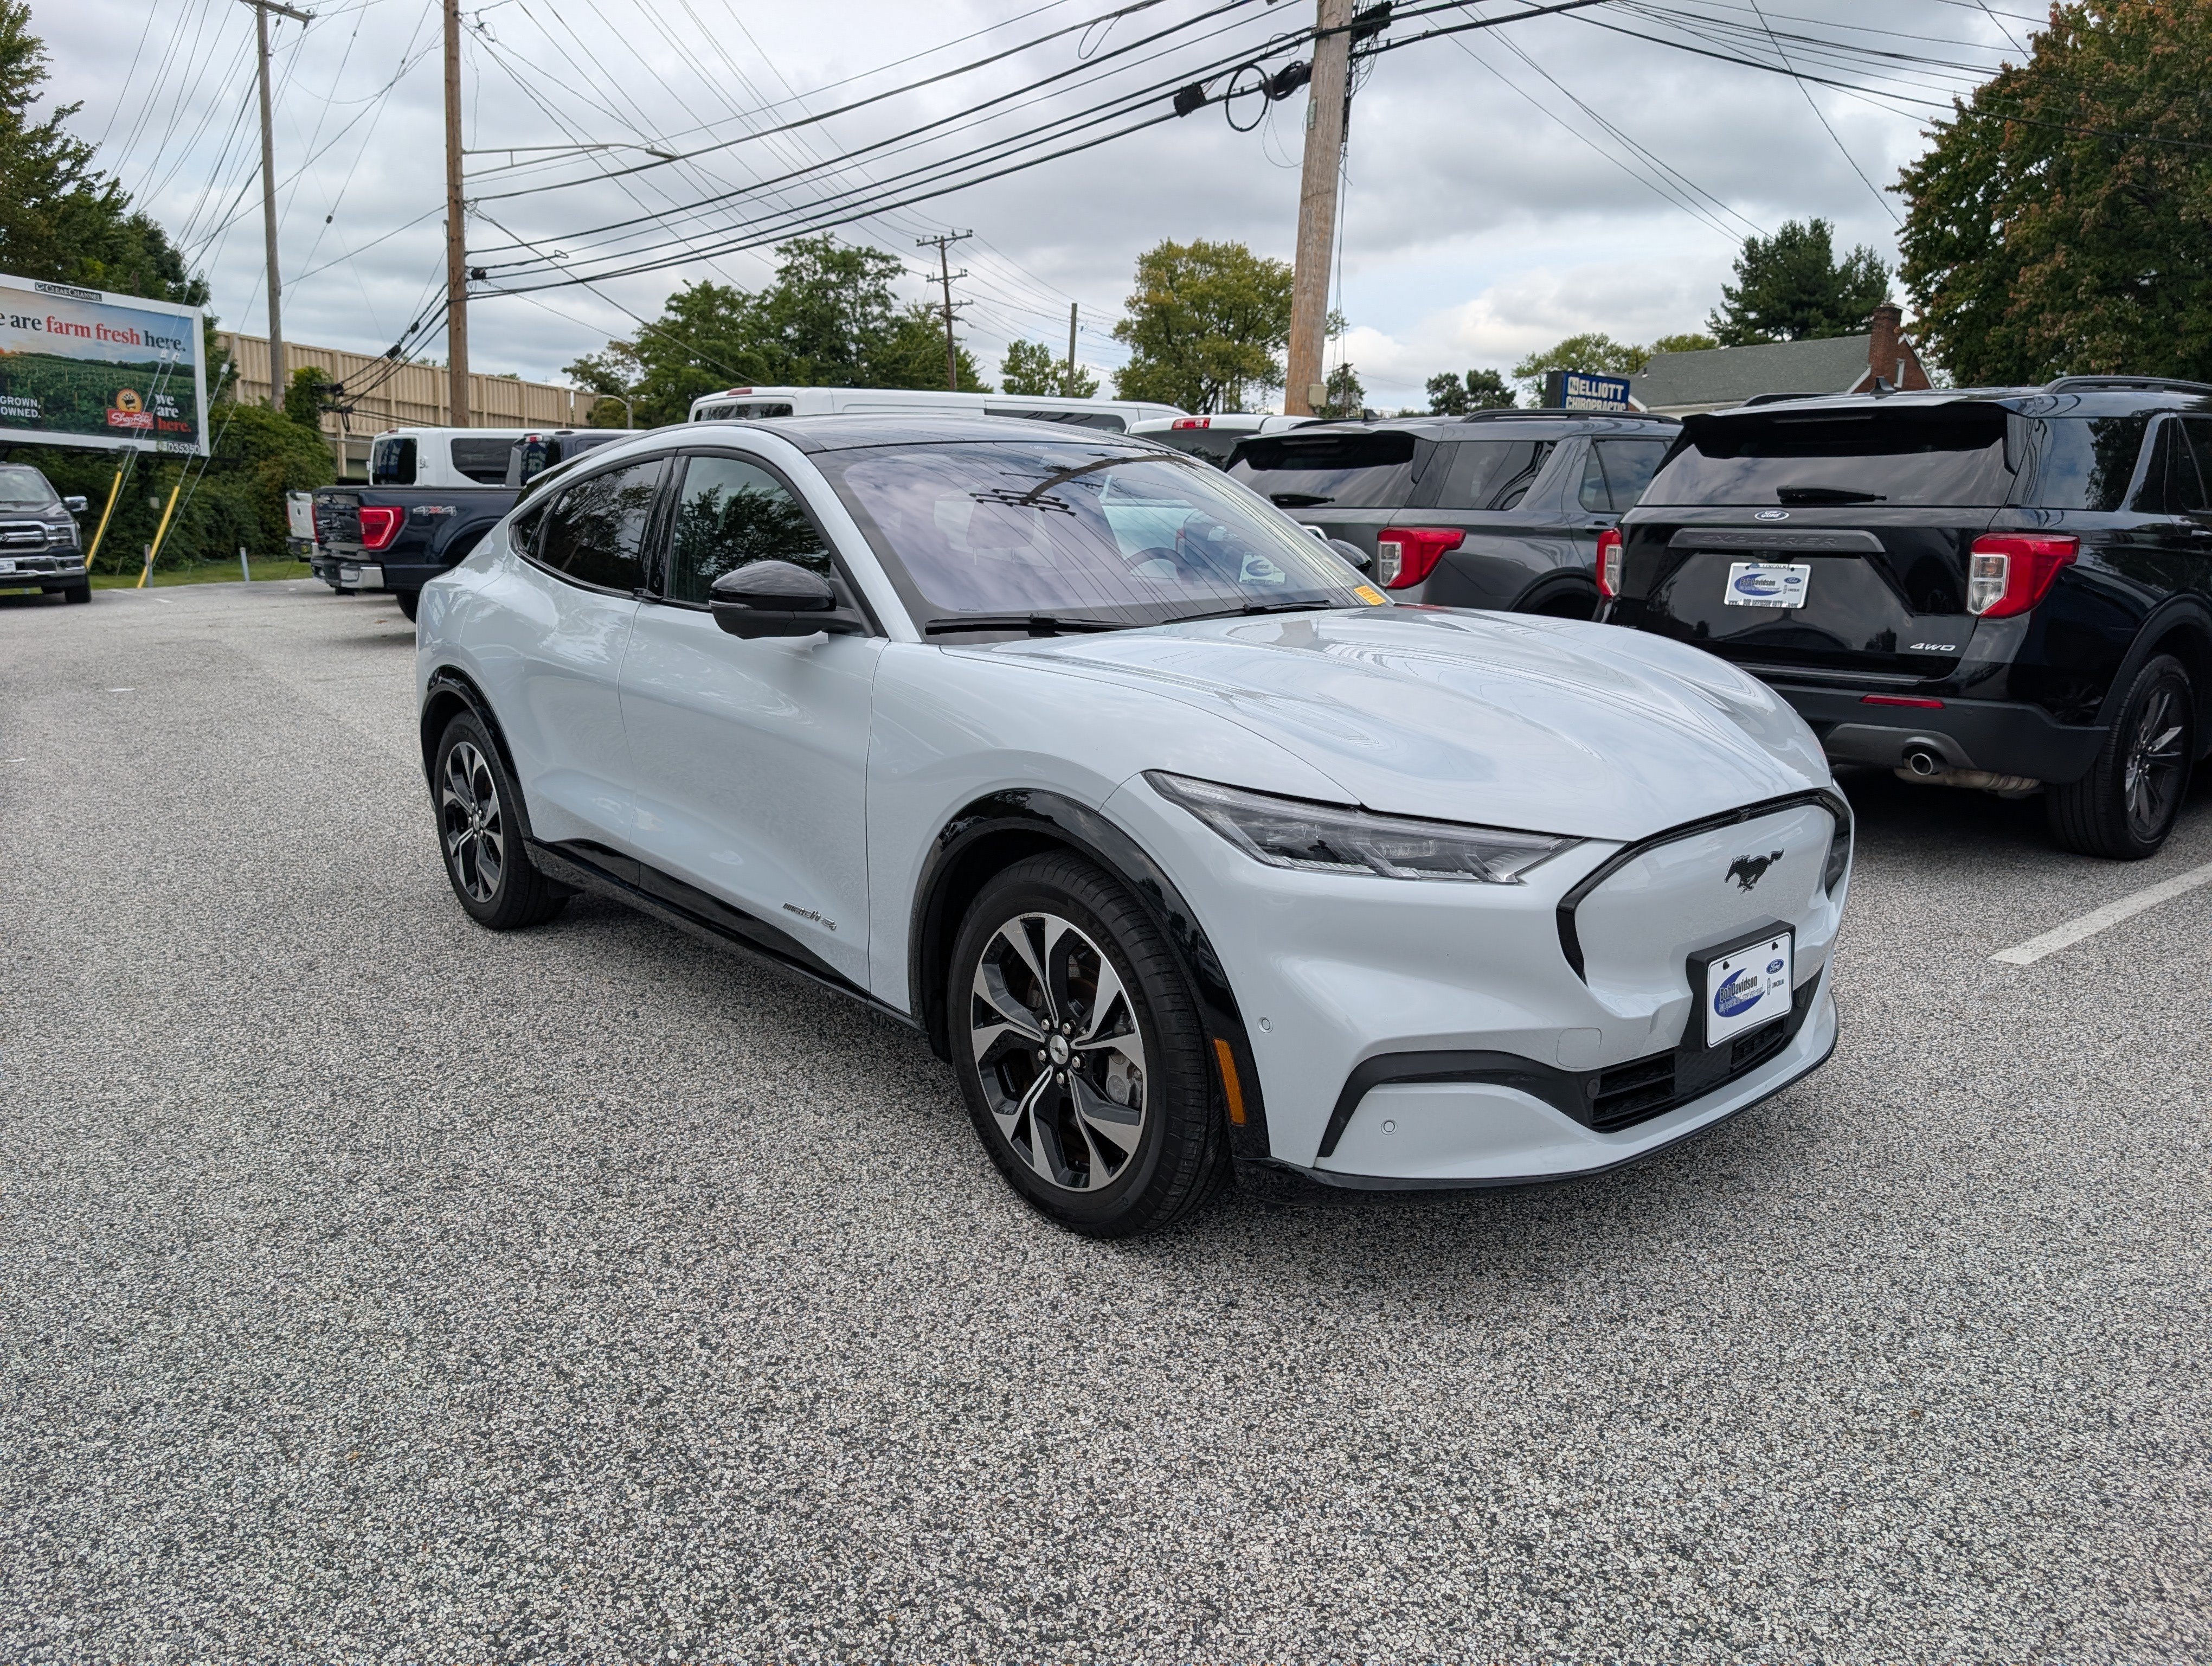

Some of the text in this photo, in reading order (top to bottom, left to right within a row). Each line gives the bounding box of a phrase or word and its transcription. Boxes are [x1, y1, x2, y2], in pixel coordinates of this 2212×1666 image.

[10, 315, 42, 331] are
[47, 315, 92, 338] farm
[95, 323, 140, 345] fresh
[144, 330, 186, 352] here.
[1579, 380, 1624, 400] ELLIOTT
[0, 395, 41, 409] GROWN,
[155, 394, 175, 406] we
[1, 407, 41, 419] OWNED.
[156, 406, 179, 418] are
[157, 418, 191, 432] here.
[1697, 535, 1837, 546] EXPLORER
[1740, 577, 1776, 587] Bob Davidson
[1909, 643, 1956, 651] 4WD
[1720, 983, 1732, 1002] Bob
[1732, 976, 1758, 996] Davidson
[1771, 978, 1784, 989] LINCOLN
